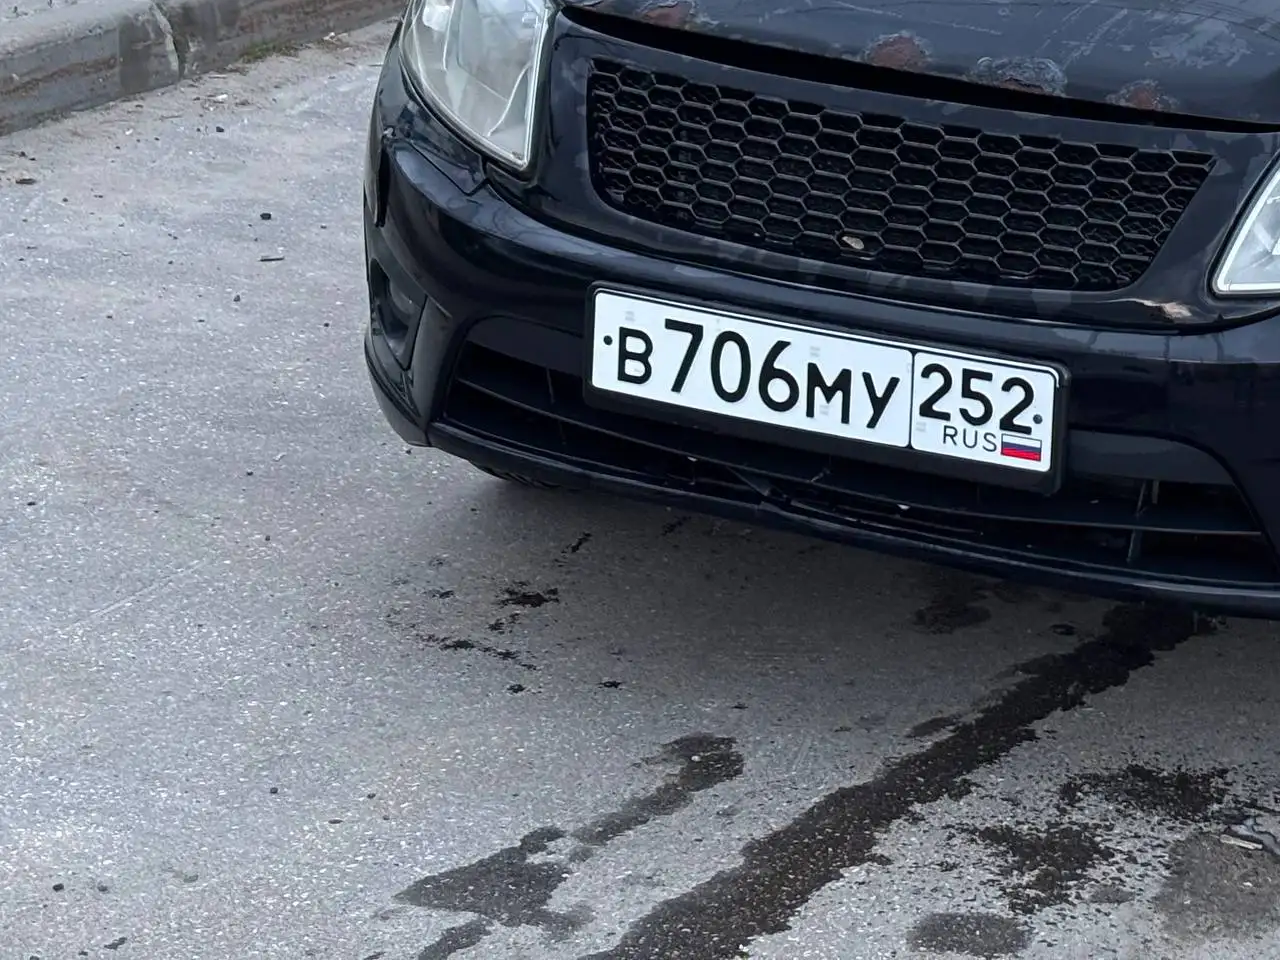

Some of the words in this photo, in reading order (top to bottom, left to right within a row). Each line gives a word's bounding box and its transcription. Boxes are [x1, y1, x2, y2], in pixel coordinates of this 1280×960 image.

[617, 318, 901, 429] В706МУ
[918, 363, 1035, 436] 252
[942, 425, 997, 453] RUS
